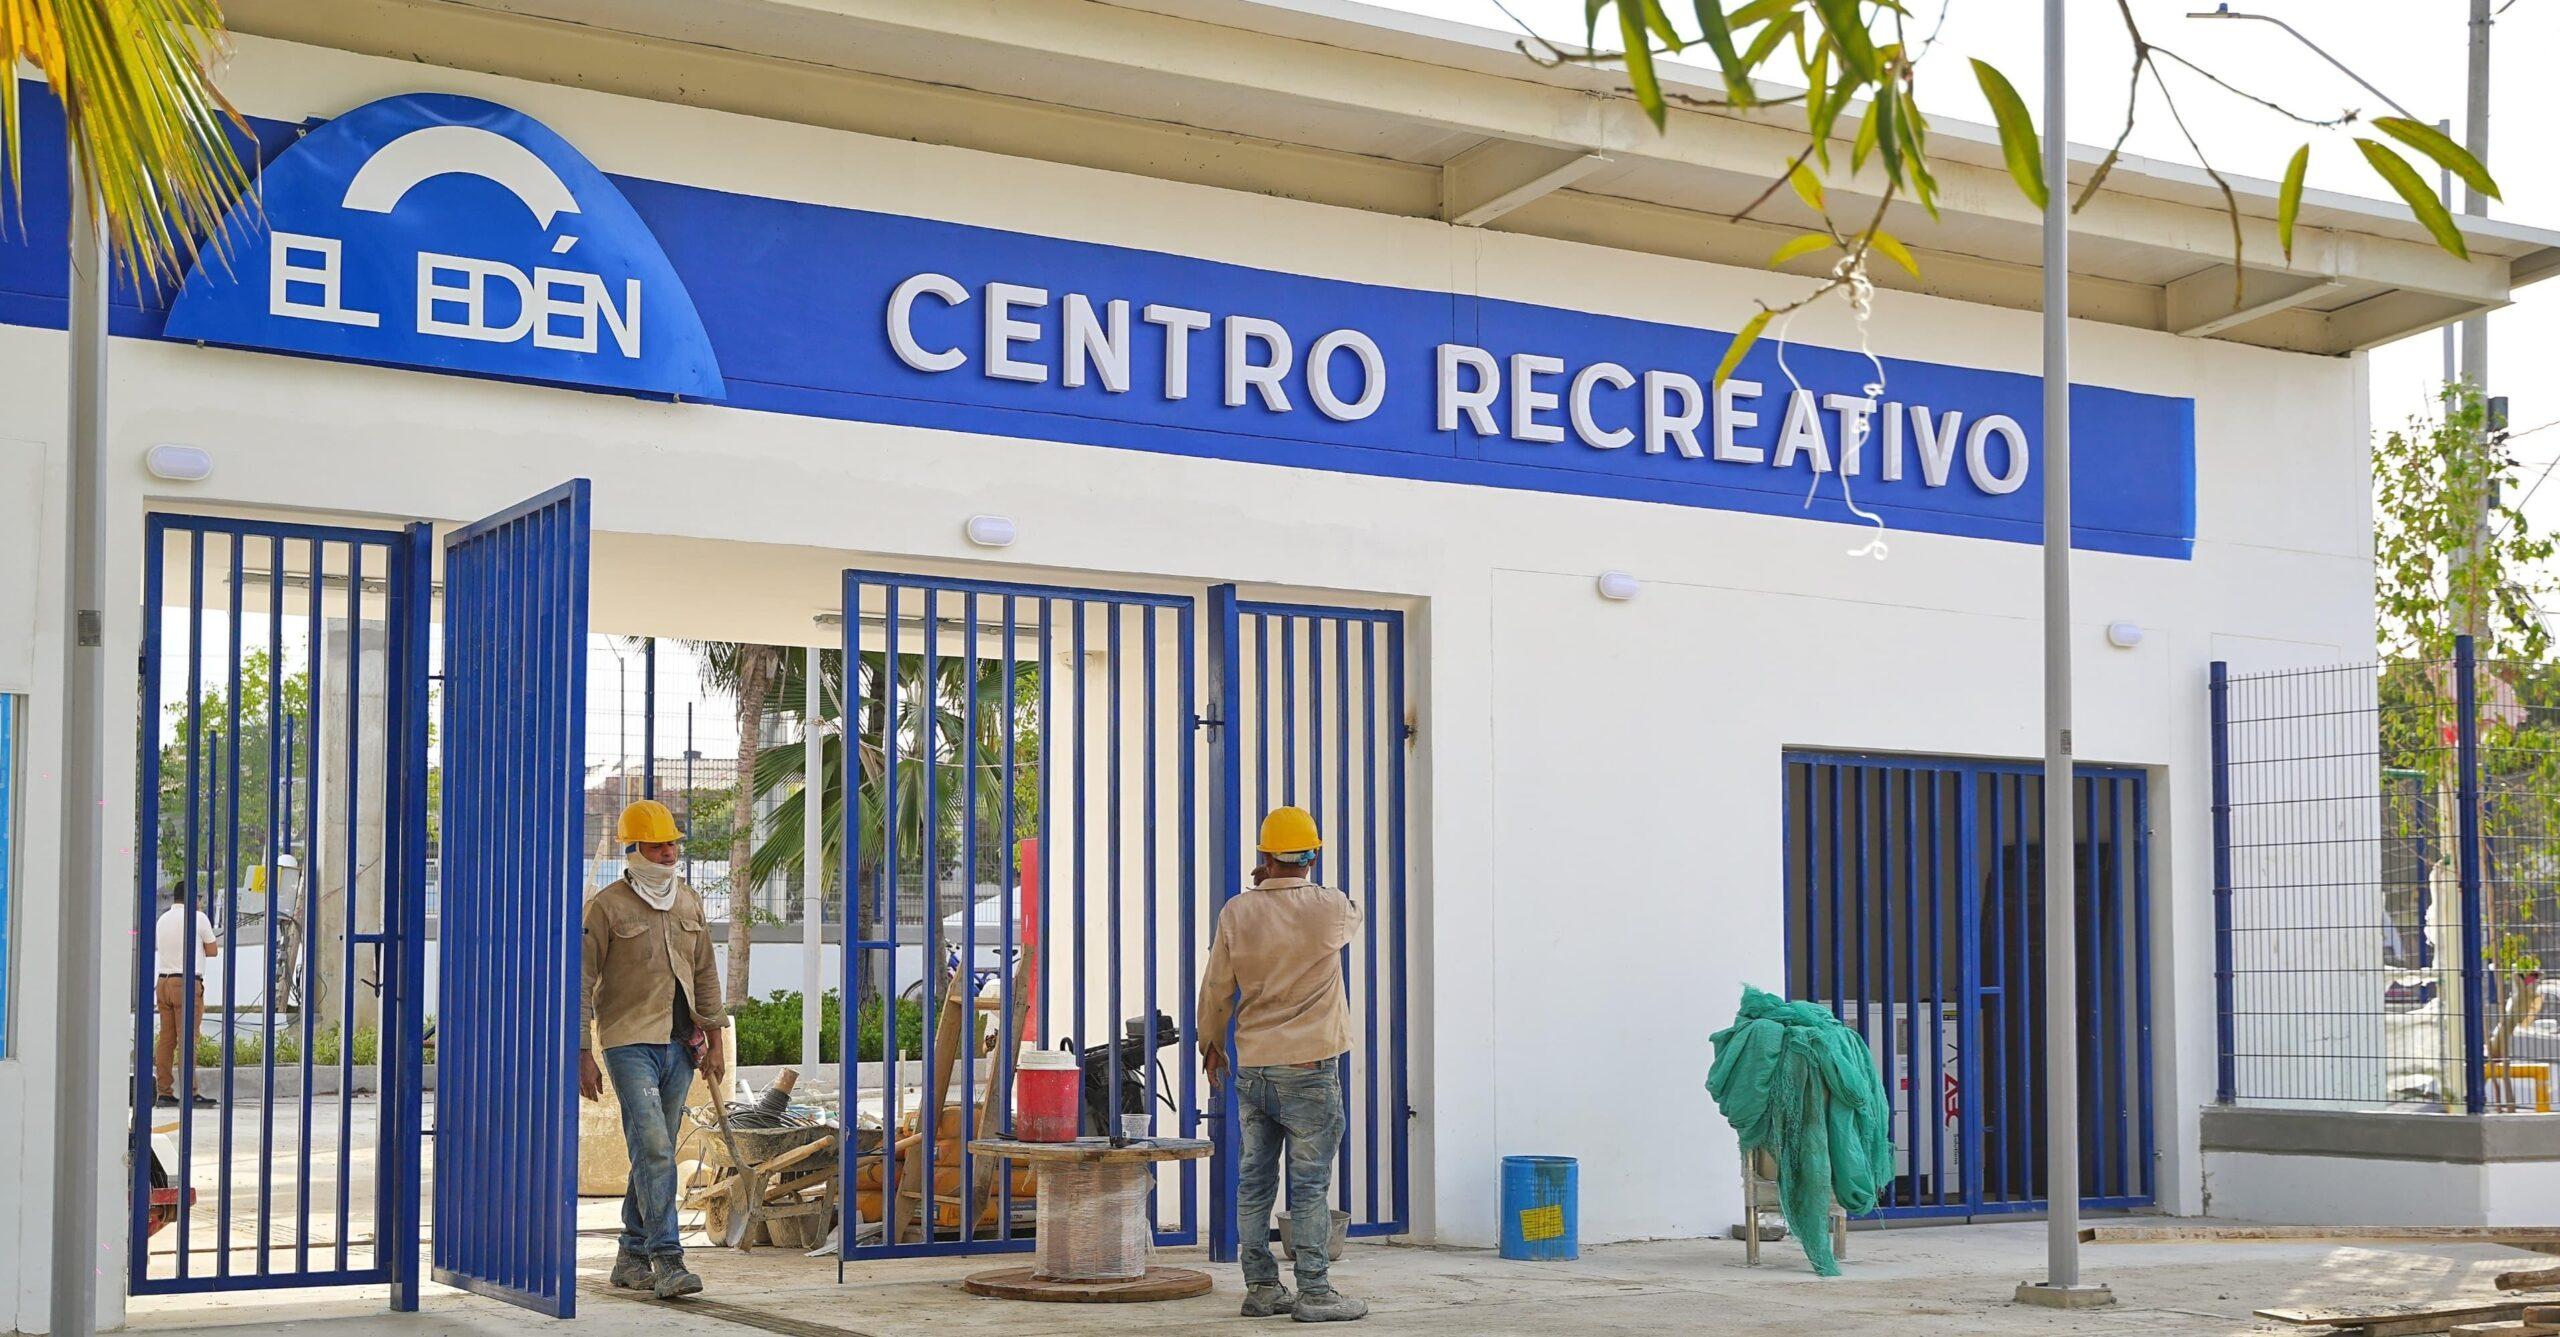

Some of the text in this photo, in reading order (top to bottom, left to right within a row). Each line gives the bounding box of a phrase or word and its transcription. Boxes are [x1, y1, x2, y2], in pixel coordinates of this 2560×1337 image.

[269, 230, 641, 359] EL EDÉN
[886, 272, 2029, 495] CENTRO RECREATIVO
